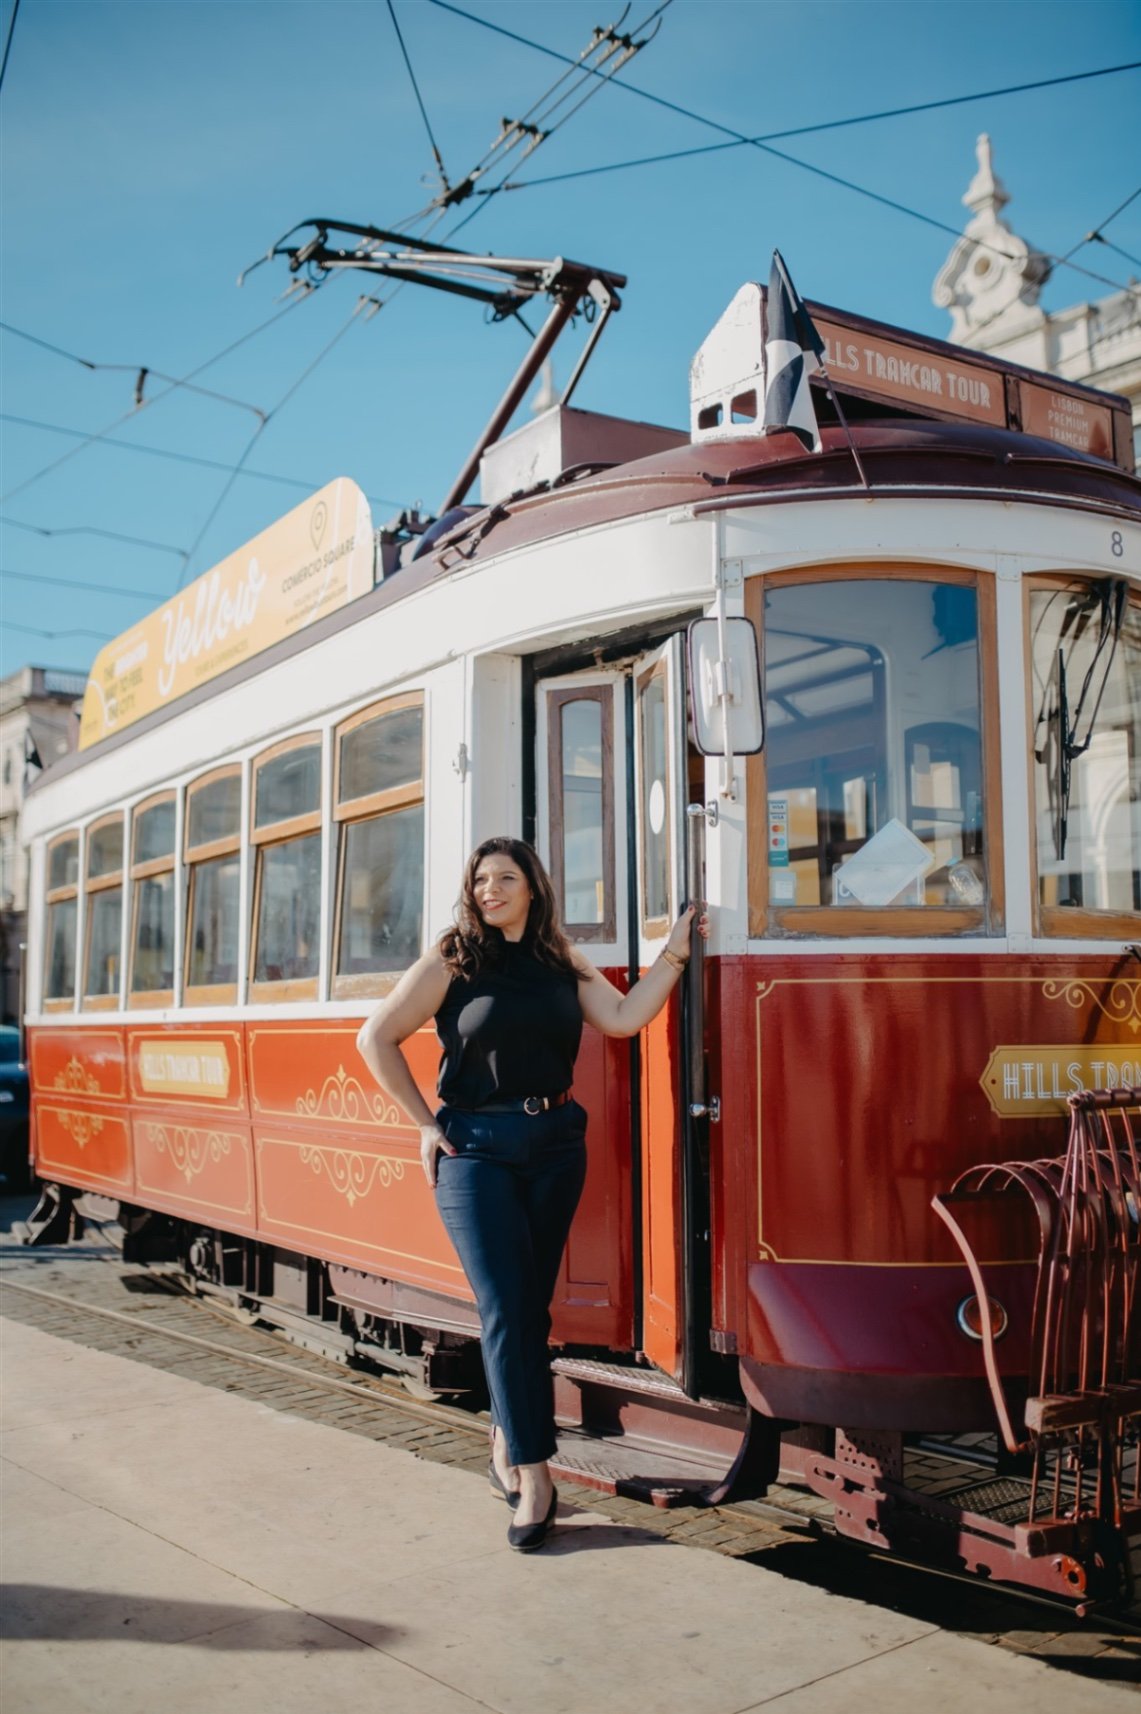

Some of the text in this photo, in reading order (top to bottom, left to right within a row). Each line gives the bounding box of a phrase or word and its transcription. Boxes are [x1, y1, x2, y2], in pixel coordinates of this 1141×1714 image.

[824, 337, 991, 409] LLS TRAMCAR TOUR
[1051, 395, 1085, 416] LISBON
[1047, 409, 1089, 433] PREMIUM
[1048, 426, 1089, 448] TRAMCAR
[323, 535, 355, 568] SQUARE
[1111, 530, 1124, 558] 8
[158, 556, 266, 697] Yellow
[1003, 1061, 1085, 1100] HILLS
